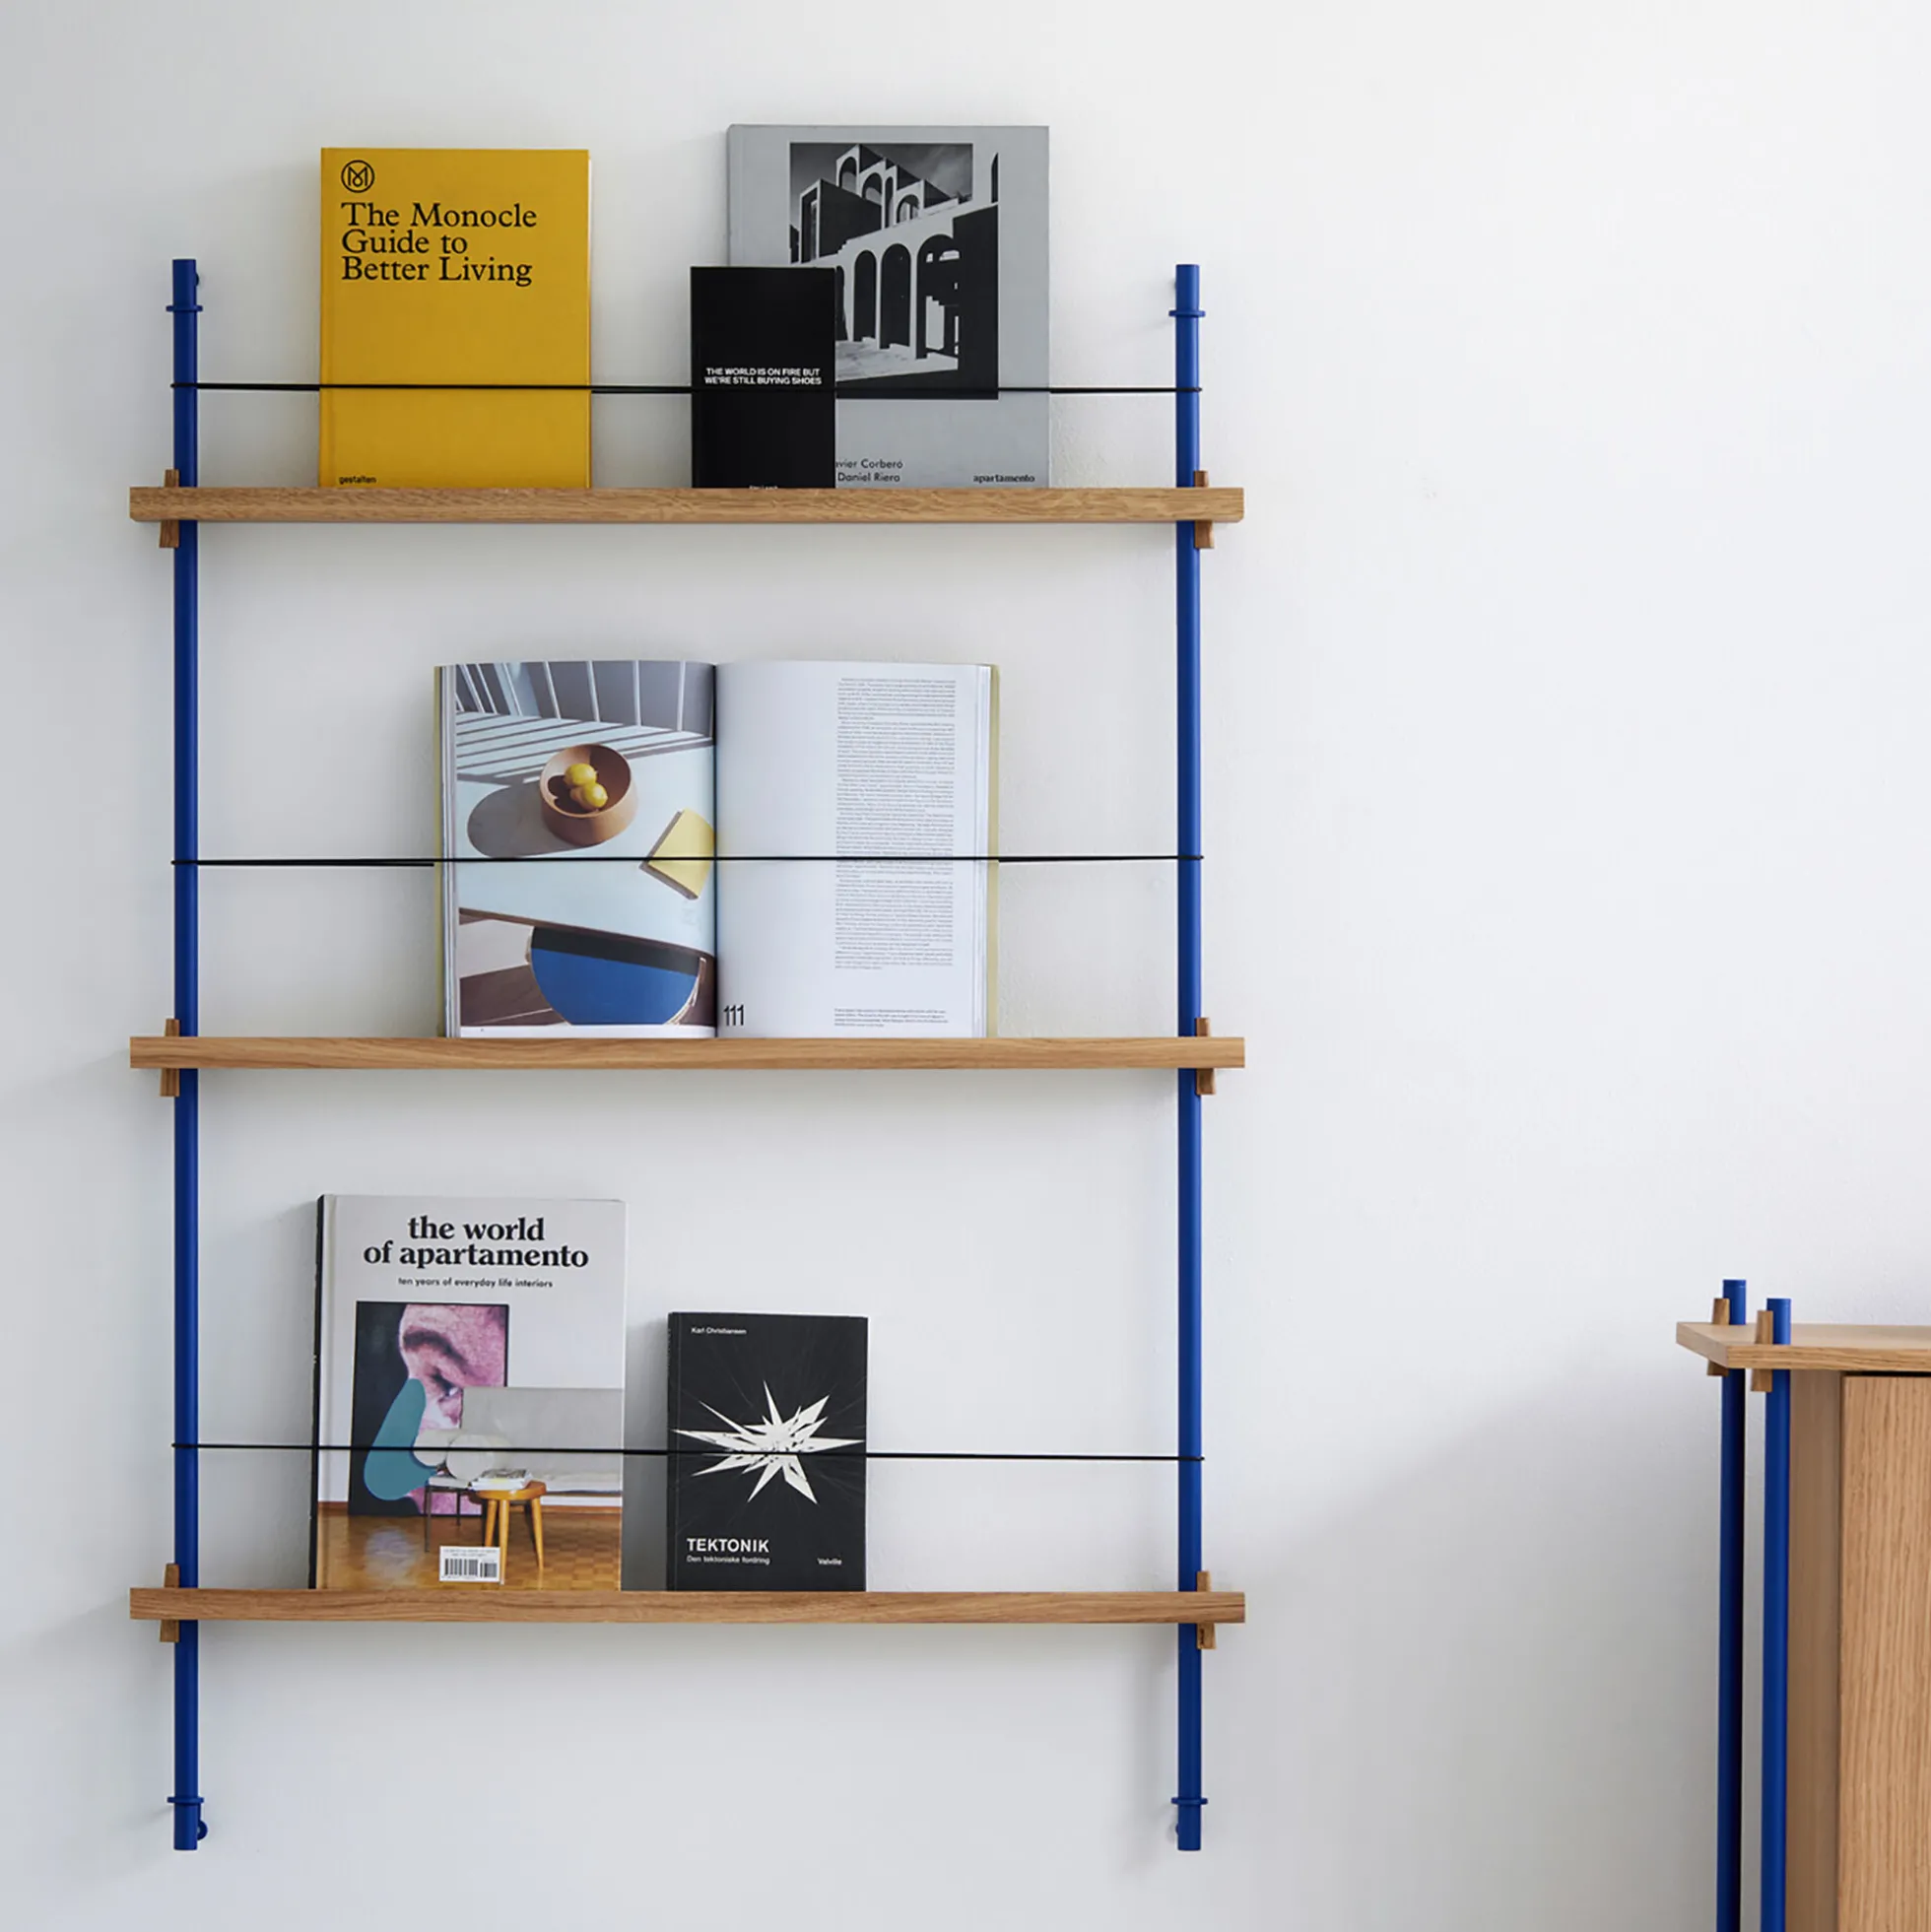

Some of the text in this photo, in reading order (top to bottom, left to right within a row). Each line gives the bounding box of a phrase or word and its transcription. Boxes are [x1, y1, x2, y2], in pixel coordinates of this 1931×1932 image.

[341, 202, 537, 228] The Monocle
[342, 229, 468, 254] Guide to
[341, 256, 533, 288] Better Living
[791, 376, 822, 385] SHOES
[338, 476, 377, 485] gestalten
[837, 471, 871, 482] Daniel
[972, 473, 1035, 484] apartamento
[722, 1004, 745, 1027] 111
[408, 1215, 545, 1241] the world
[364, 1239, 589, 1269] of apartamento
[443, 1277, 452, 1286] of
[454, 1279, 496, 1288] everyday
[515, 1279, 554, 1288] interiors
[687, 1538, 769, 1553] TEKTONIK
